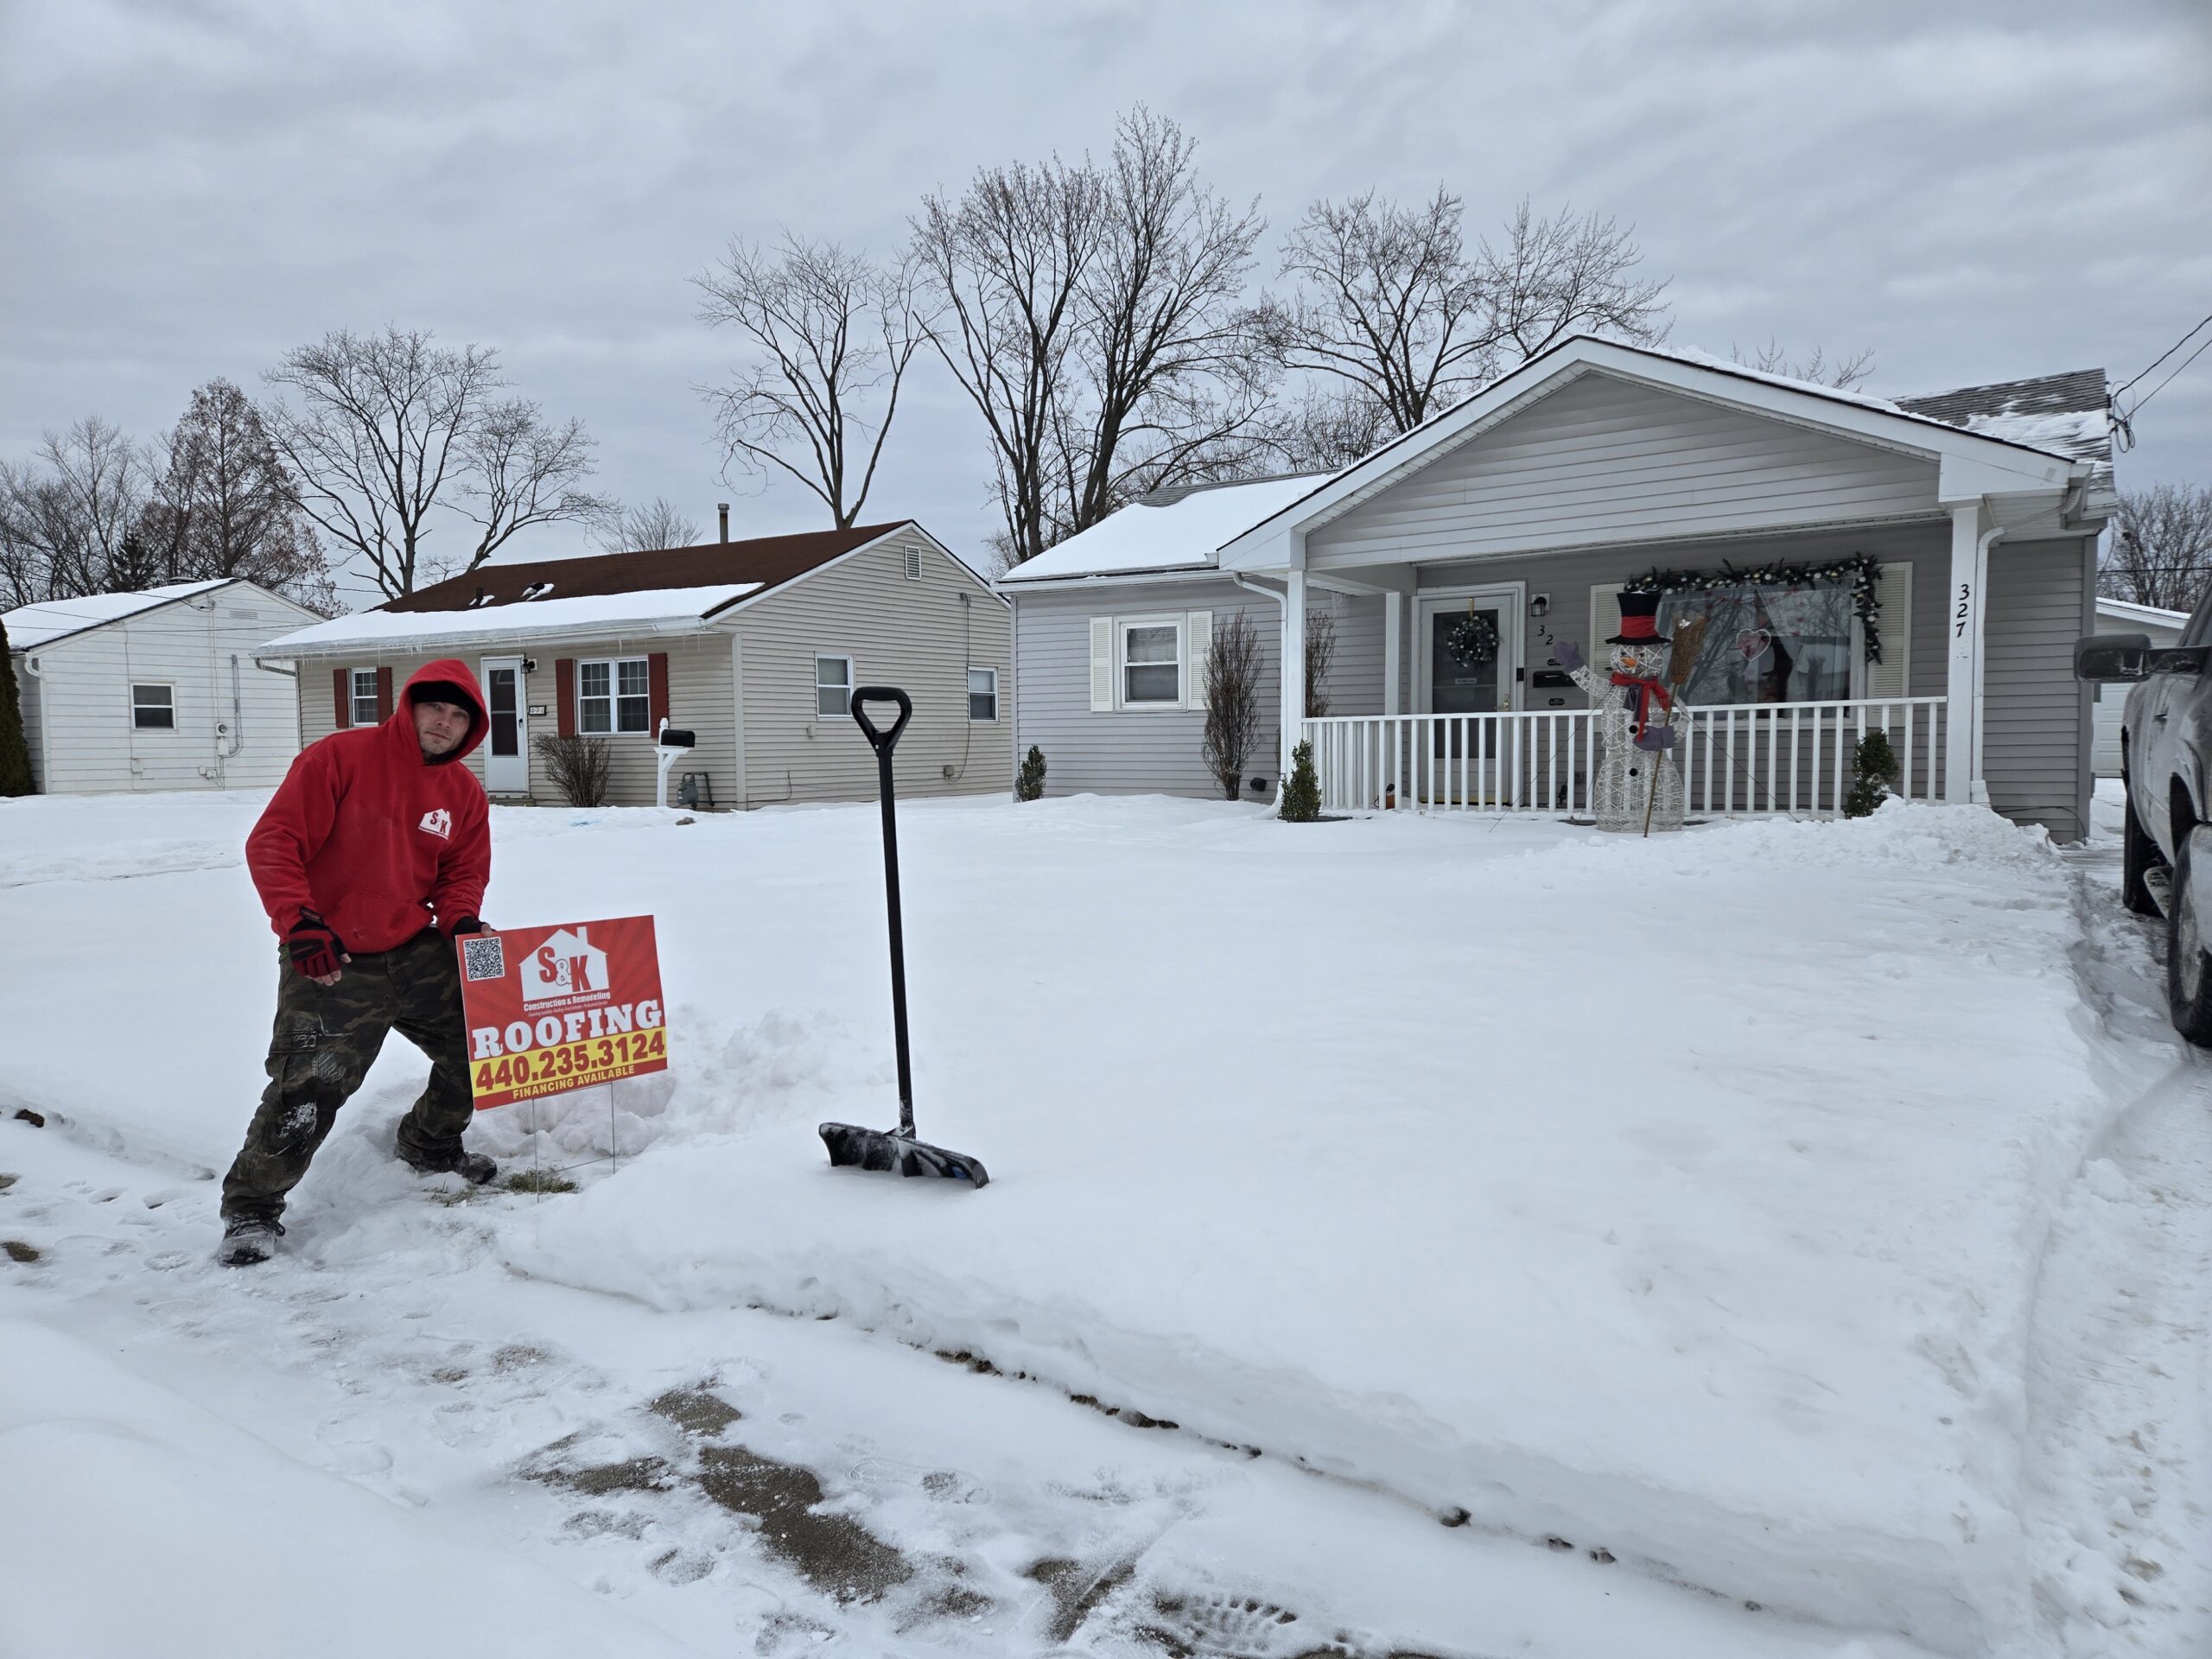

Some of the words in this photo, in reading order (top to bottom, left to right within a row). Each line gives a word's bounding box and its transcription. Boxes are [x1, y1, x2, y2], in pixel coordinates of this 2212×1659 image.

[1955, 583, 1970, 639] 327
[537, 946, 592, 993] S&K
[524, 997, 566, 1012] Construction
[572, 991, 611, 1003] Remodeling
[472, 999, 662, 1060] ROOFING
[475, 1030, 664, 1091] 440.235.3124
[512, 1078, 574, 1100] FINANCING
[577, 1065, 635, 1086] AVAILABLE
